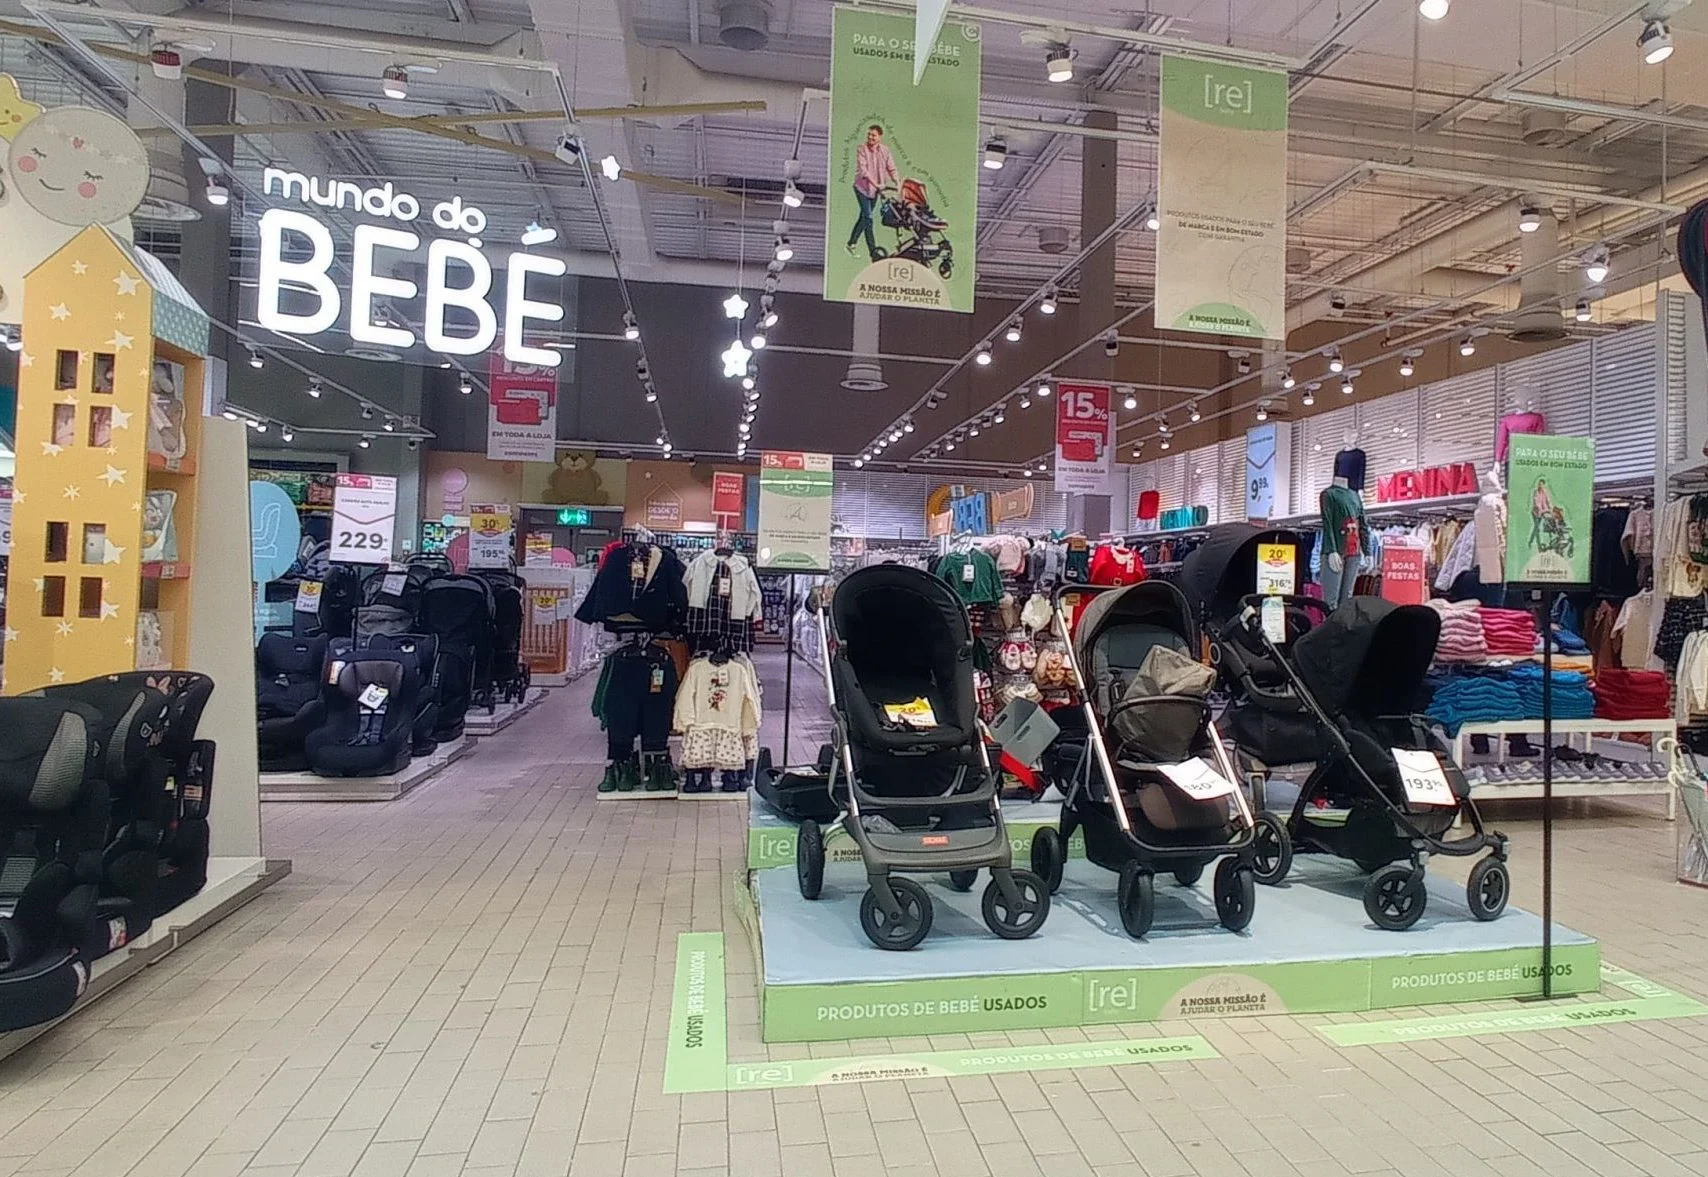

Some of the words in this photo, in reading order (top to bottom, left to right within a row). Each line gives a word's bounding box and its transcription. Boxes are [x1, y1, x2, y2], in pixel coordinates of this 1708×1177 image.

[853, 33, 885, 47] PARA
[889, 38, 899, 48] O
[902, 40, 916, 51] SE
[853, 47, 888, 58] USADOS
[890, 52, 904, 61] EM
[1204, 74, 1252, 113] [re]
[264, 167, 420, 221] mundo
[432, 195, 487, 234] do
[888, 262, 914, 282] [re]
[257, 207, 567, 368] BEBÉ
[859, 283, 866, 291] A
[868, 284, 897, 294] NOSSA
[900, 286, 933, 297] MISSÃO
[859, 292, 893, 301] AJUDAR
[903, 295, 940, 305] PLANETA
[1195, 315, 1218, 324] NOSSA
[1061, 391, 1108, 420] 15%
[1377, 462, 1479, 503] MENINA
[338, 531, 383, 550] 229
[1387, 571, 1419, 581] FESTAS
[1391, 562, 1416, 570] BOAS
[760, 834, 797, 860] [re]
[1391, 972, 1465, 989] PRODUTOS
[1467, 970, 1485, 983] DE
[1488, 965, 1520, 982] BEBÉ
[1089, 977, 1137, 1012] [re]
[1180, 998, 1188, 1007] A
[1190, 997, 1221, 1006] NOSSA
[1223, 993, 1258, 1004] MISSÃO
[1260, 992, 1267, 1002] É
[816, 1003, 909, 1021] PRODUTOS
[913, 1001, 935, 1016] DE
[939, 995, 980, 1015] BEBÉ
[983, 995, 1048, 1011] USADOS
[1180, 1006, 1215, 1015] AJUDAR
[1217, 1005, 1224, 1013] O
[1226, 1003, 1266, 1013] PLANETA
[685, 1014, 704, 1048] USADOS
[1393, 1020, 1492, 1036] PRODUTOS
[1494, 1018, 1517, 1026] DE
[1565, 1007, 1637, 1020] USADOS
[960, 1053, 1055, 1067] PRODUTOS
[1057, 1051, 1079, 1060] DE
[1126, 1044, 1194, 1055] USADOS
[736, 1064, 793, 1084] [re]
